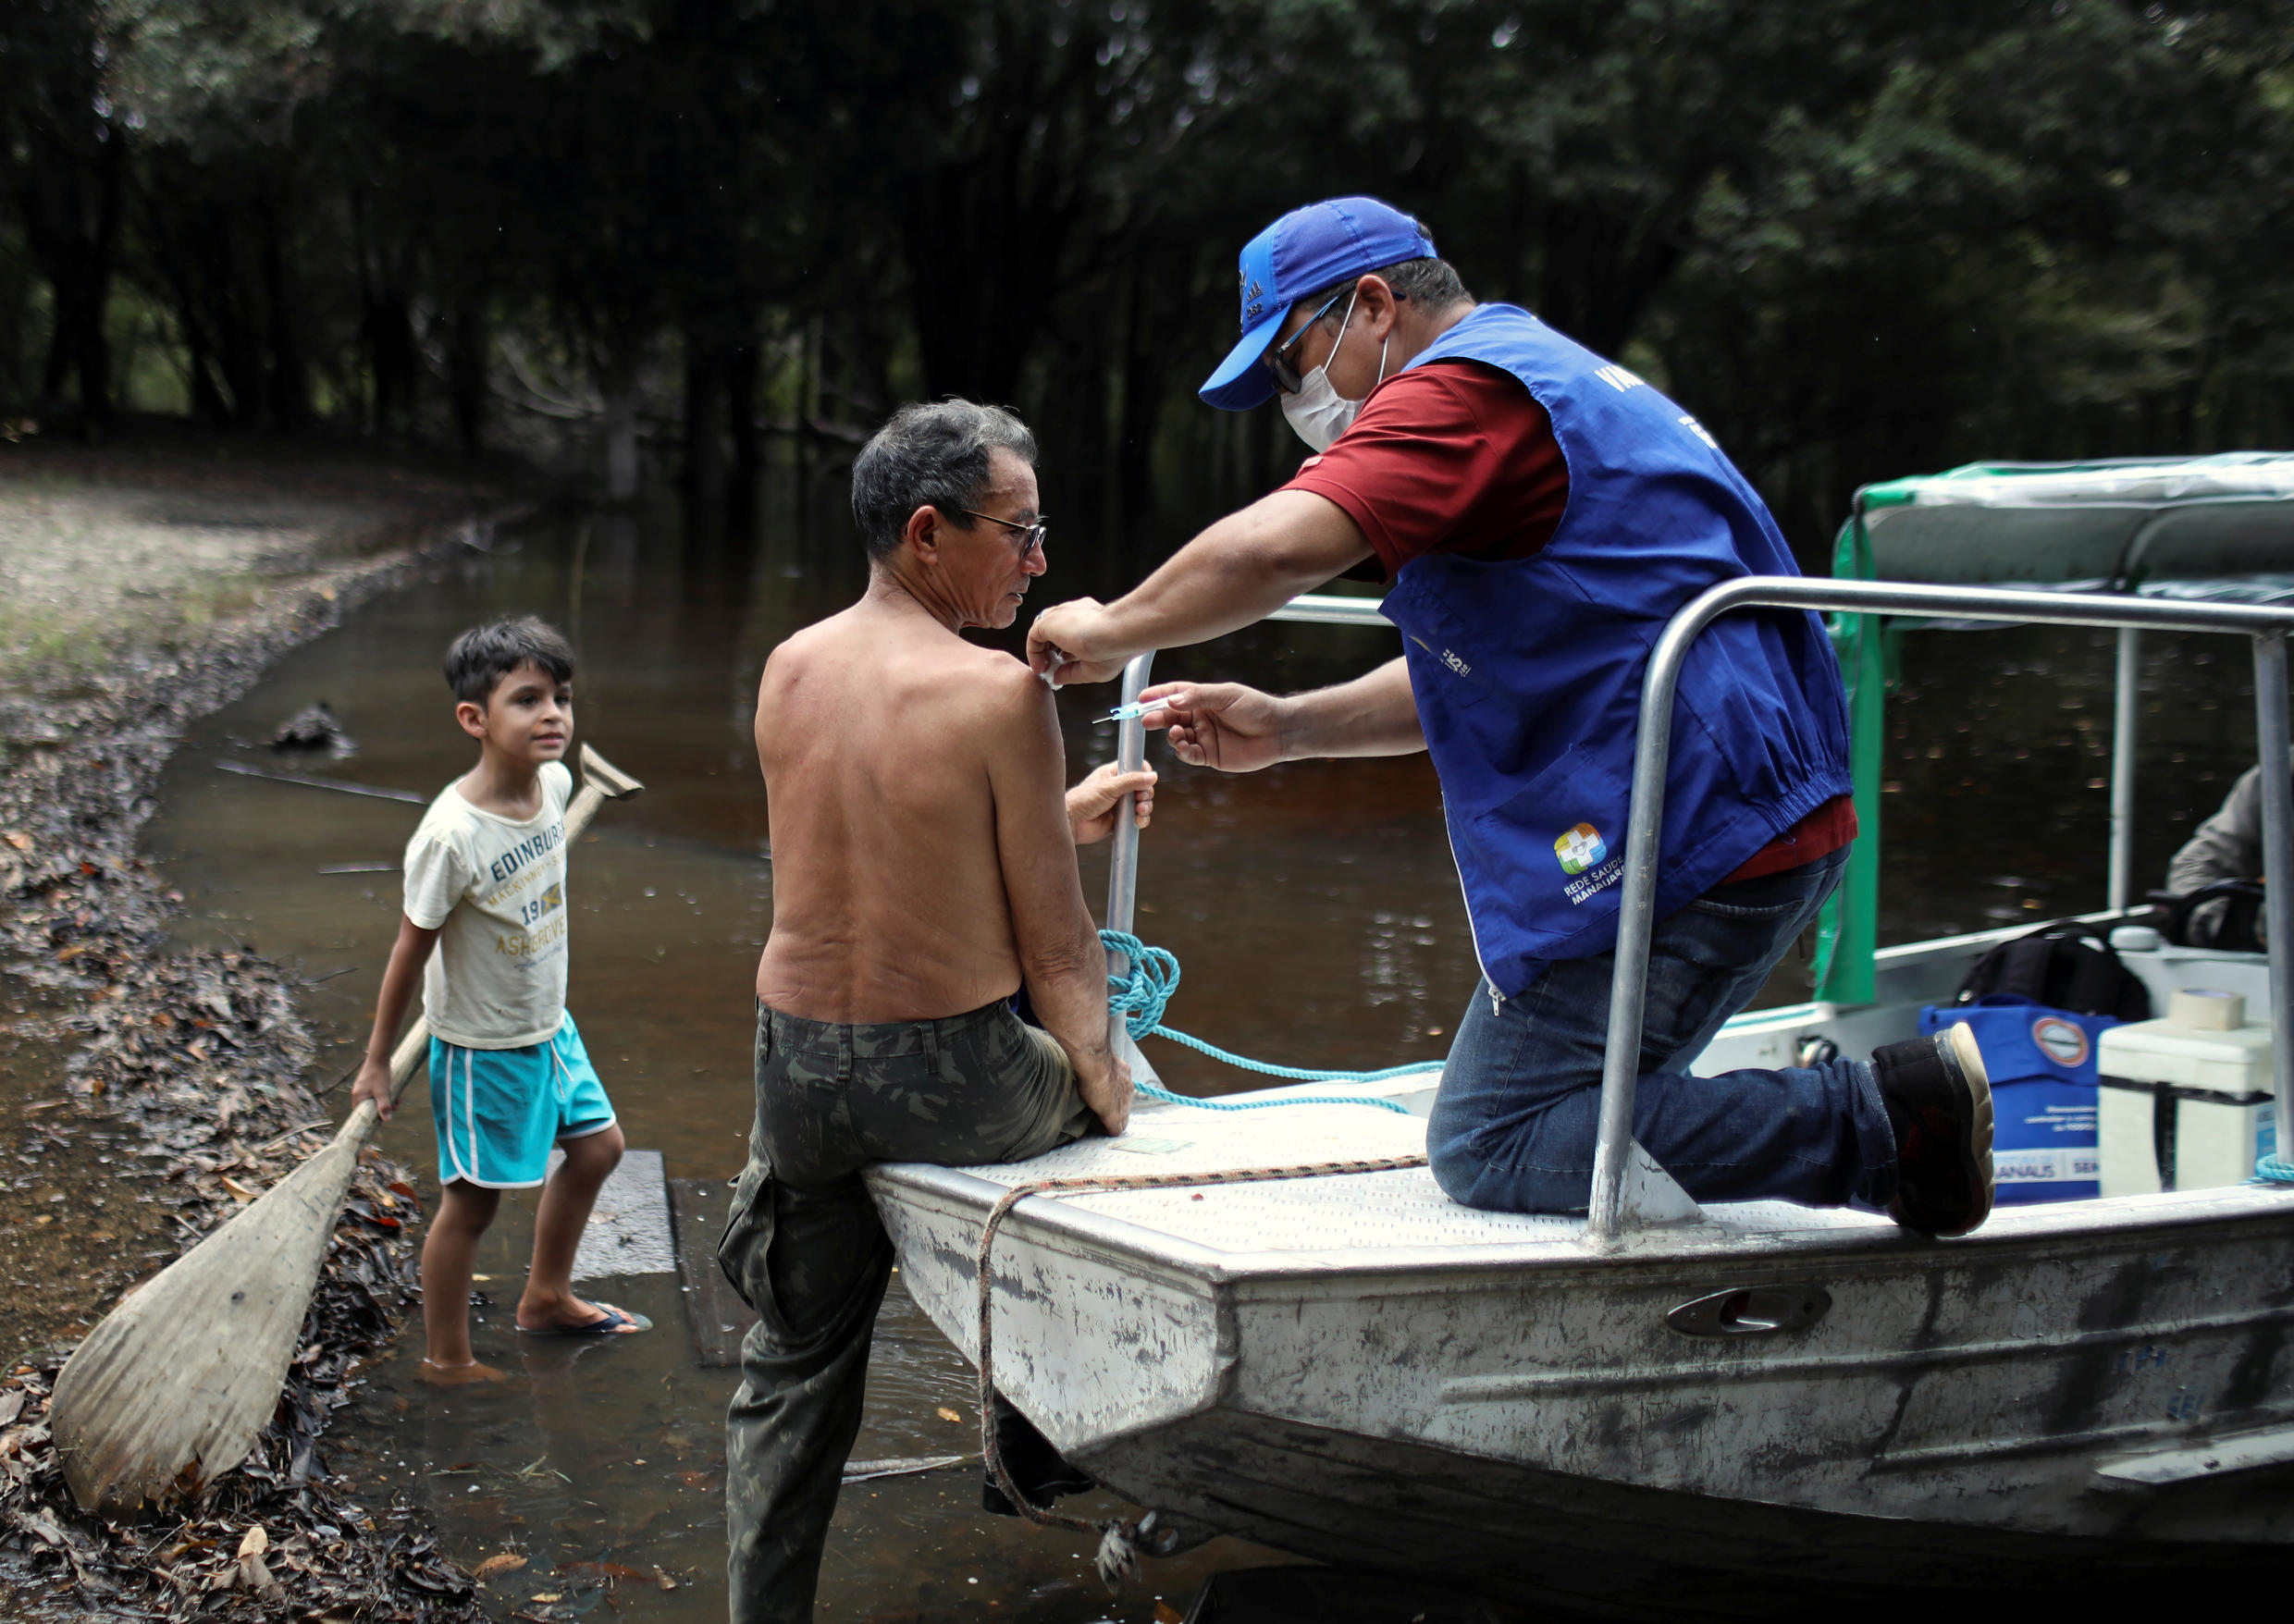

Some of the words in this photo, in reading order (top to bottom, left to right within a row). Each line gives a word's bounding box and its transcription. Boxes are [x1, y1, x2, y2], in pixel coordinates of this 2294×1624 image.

[490, 820, 565, 882] EDINBURG
[1563, 876, 1591, 897] REDE
[1572, 865, 1625, 905] MANAUAR
